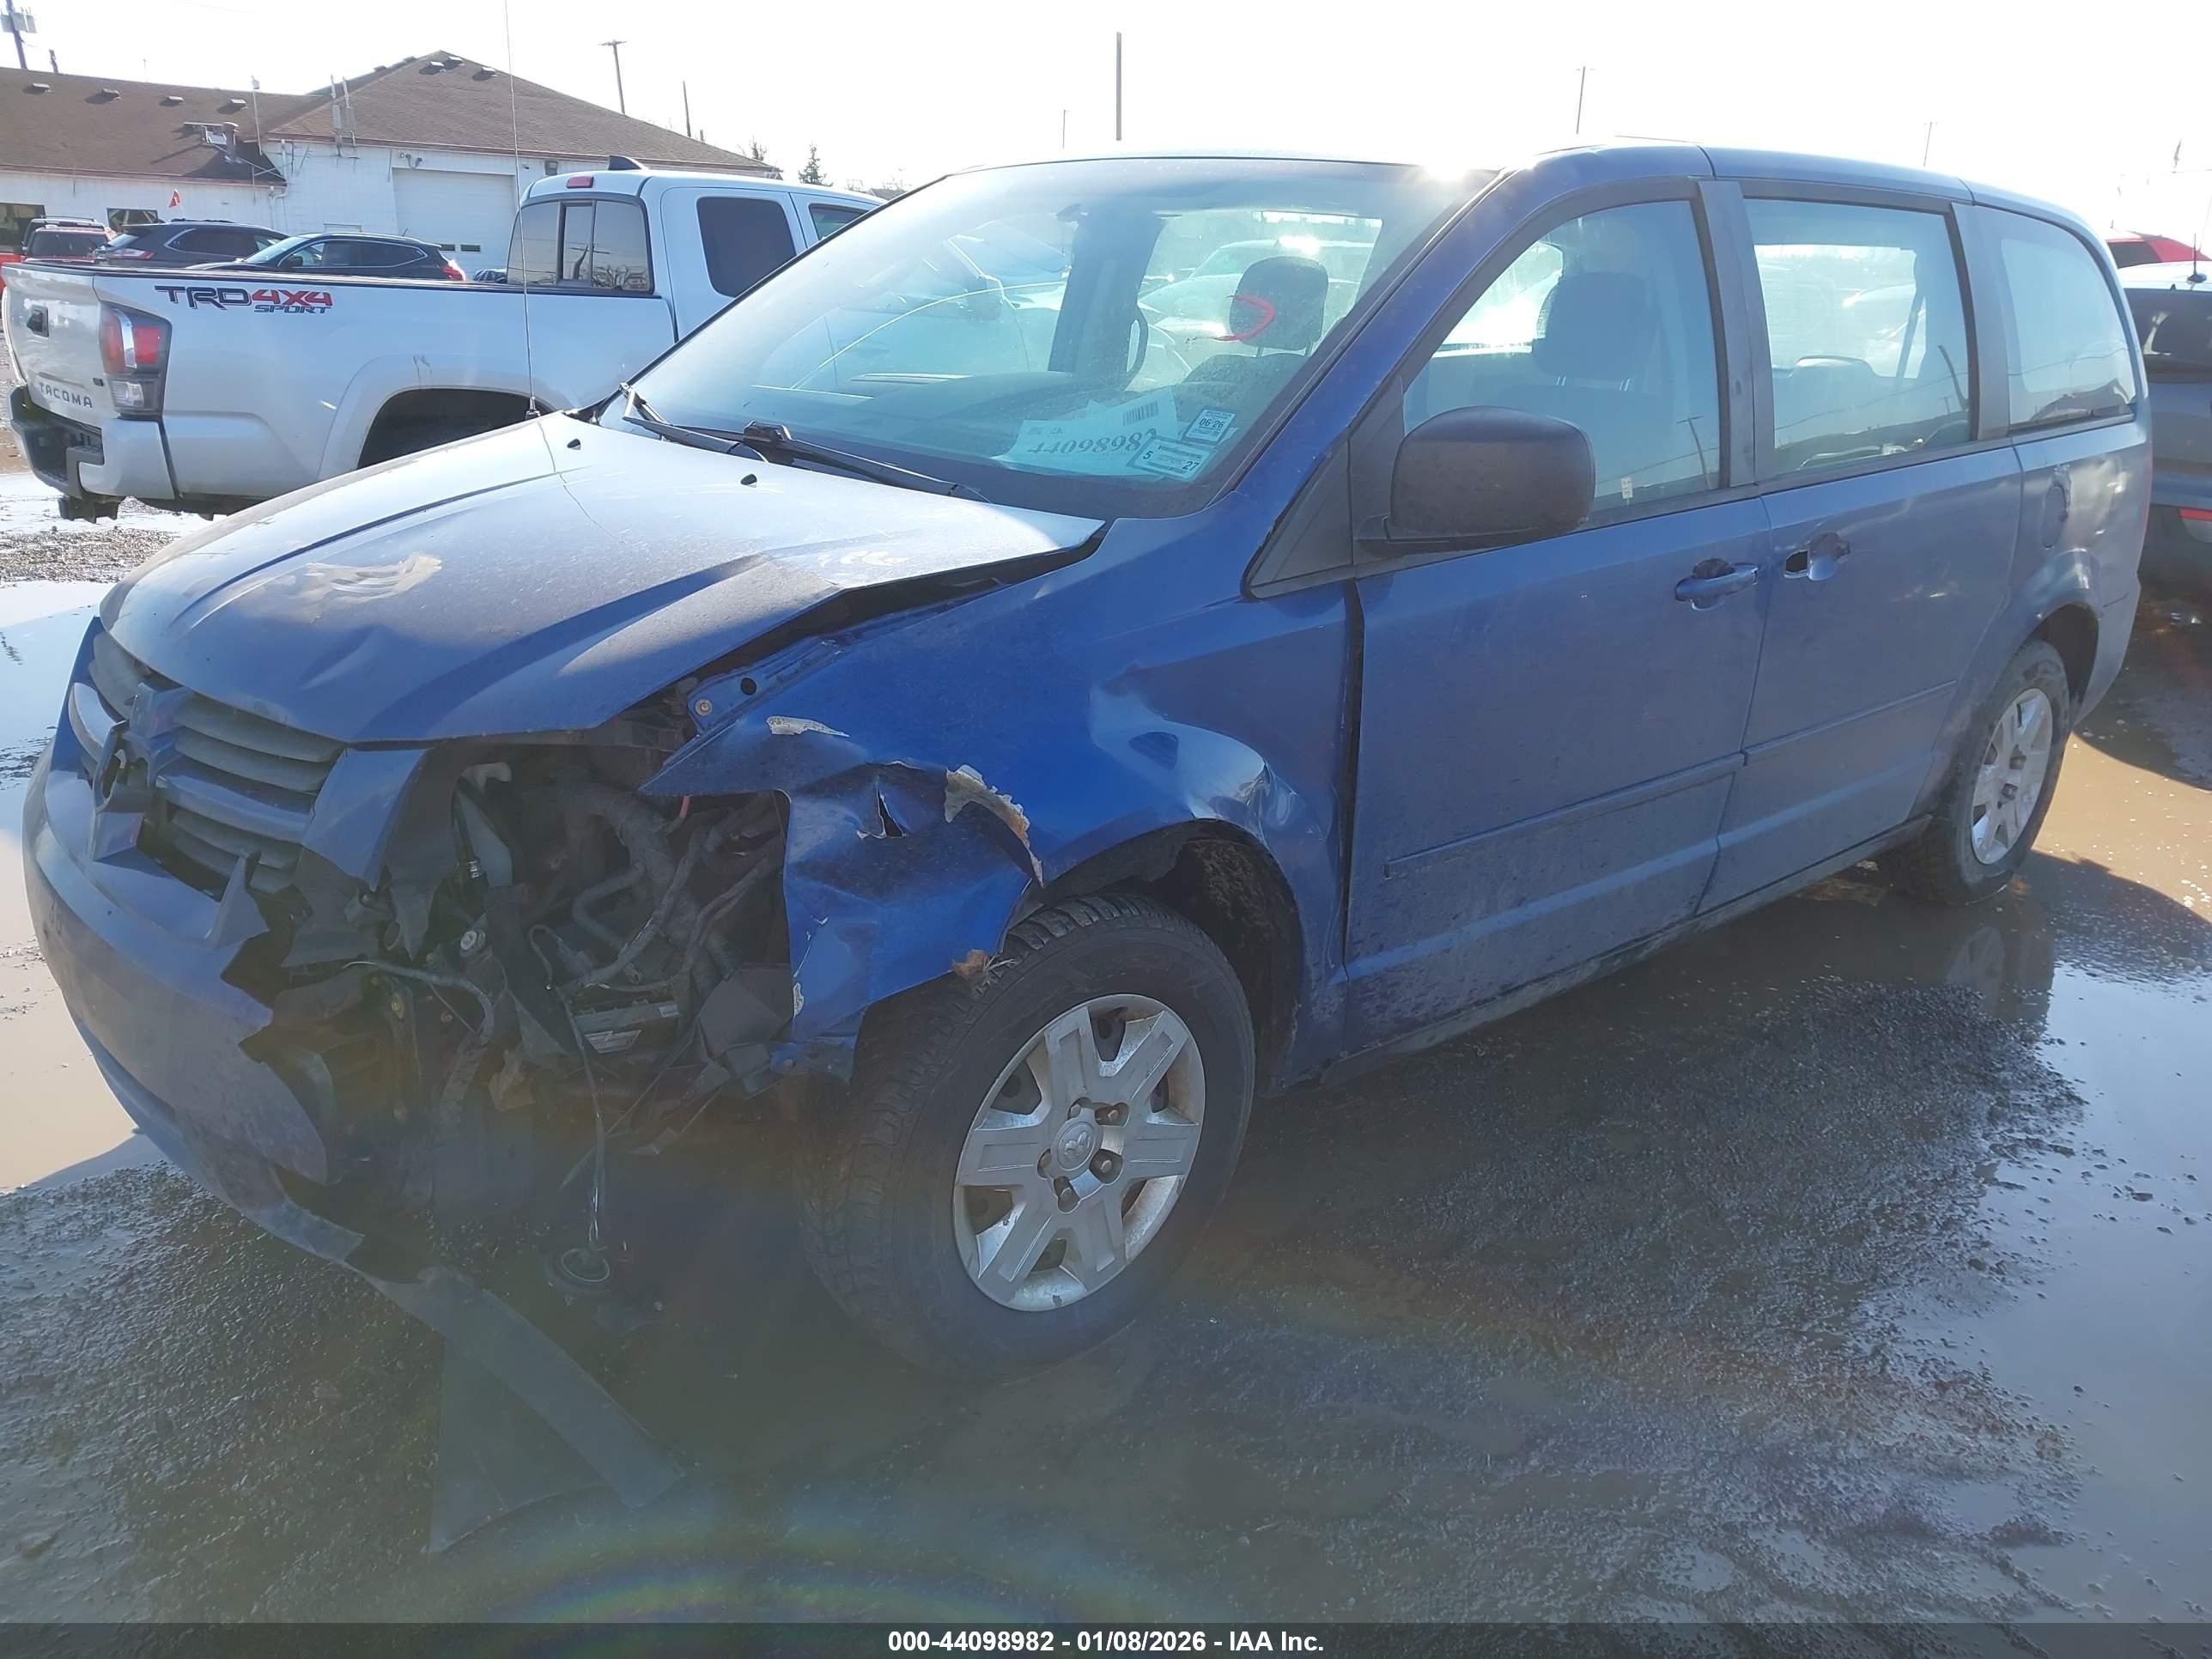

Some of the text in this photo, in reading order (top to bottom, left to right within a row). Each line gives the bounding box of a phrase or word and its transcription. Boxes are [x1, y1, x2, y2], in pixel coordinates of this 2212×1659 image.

[155, 285, 252, 311] TRD
[253, 304, 332, 314] SPORT
[39, 381, 93, 409] TACOMA
[1142, 450, 1154, 460] 5
[1181, 459, 1200, 471] 27
